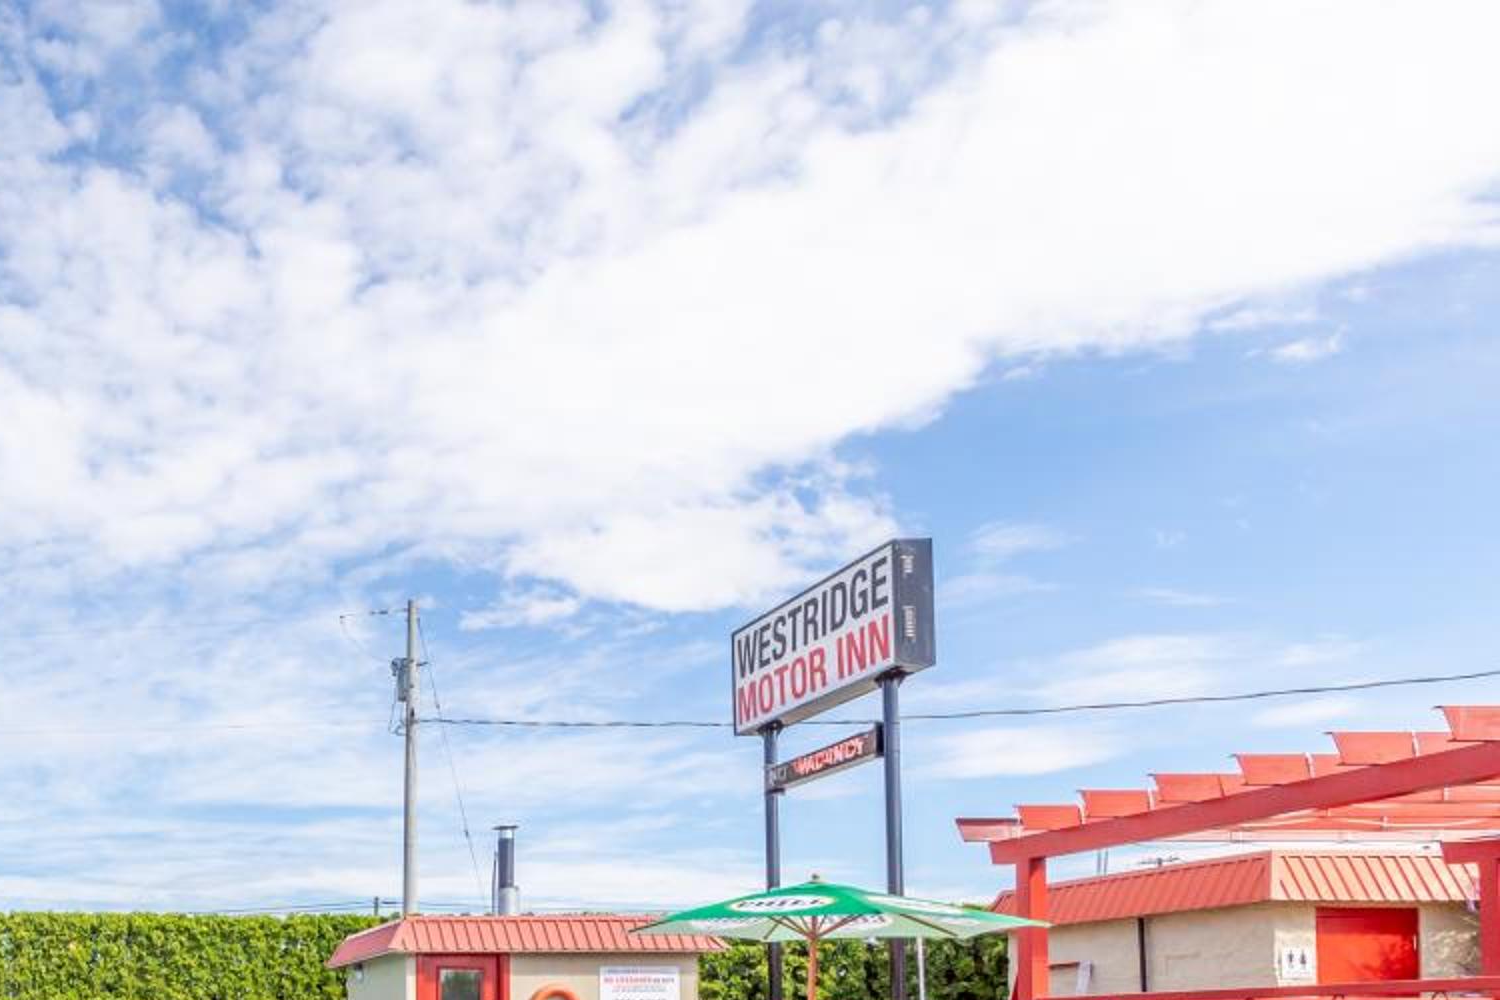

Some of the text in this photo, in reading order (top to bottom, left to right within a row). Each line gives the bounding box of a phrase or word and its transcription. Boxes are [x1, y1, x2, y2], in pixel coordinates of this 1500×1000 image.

[737, 556, 889, 678] WESTRIDGE
[737, 647, 827, 725] MOTOR
[836, 614, 890, 680] INN
[793, 738, 864, 775] VACANCY
